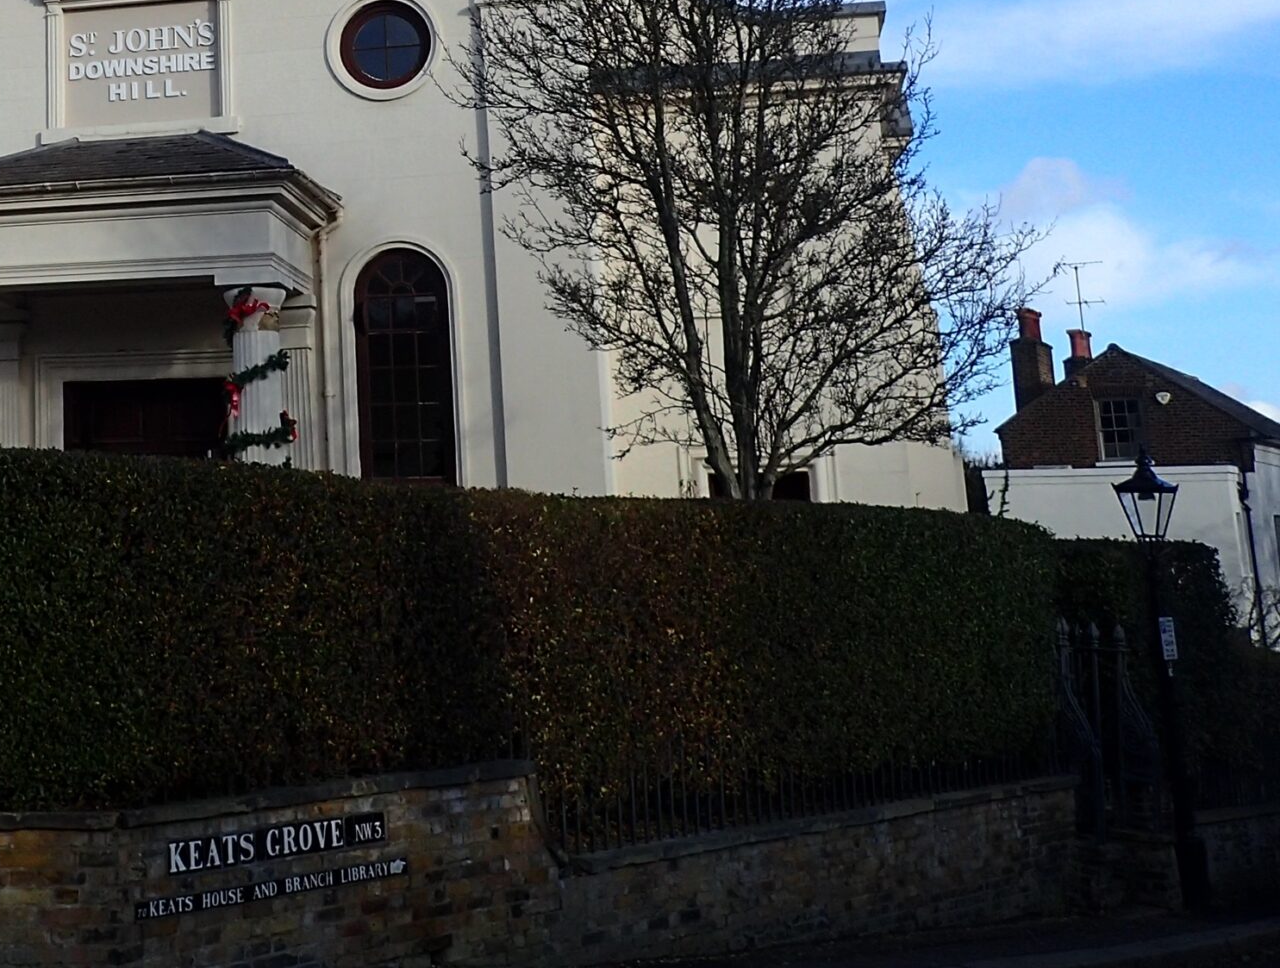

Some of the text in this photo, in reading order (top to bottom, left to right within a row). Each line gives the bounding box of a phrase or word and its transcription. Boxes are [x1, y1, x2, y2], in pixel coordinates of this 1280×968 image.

[108, 18, 215, 54] JOHN'S
[69, 51, 215, 81] DOWNSHIRE
[109, 79, 187, 101] HILL.
[169, 833, 255, 873] KEATS
[266, 819, 344, 856] GROVE
[137, 861, 390, 918] TO KEATS HOUSE AND BRANCH LIBRARY
